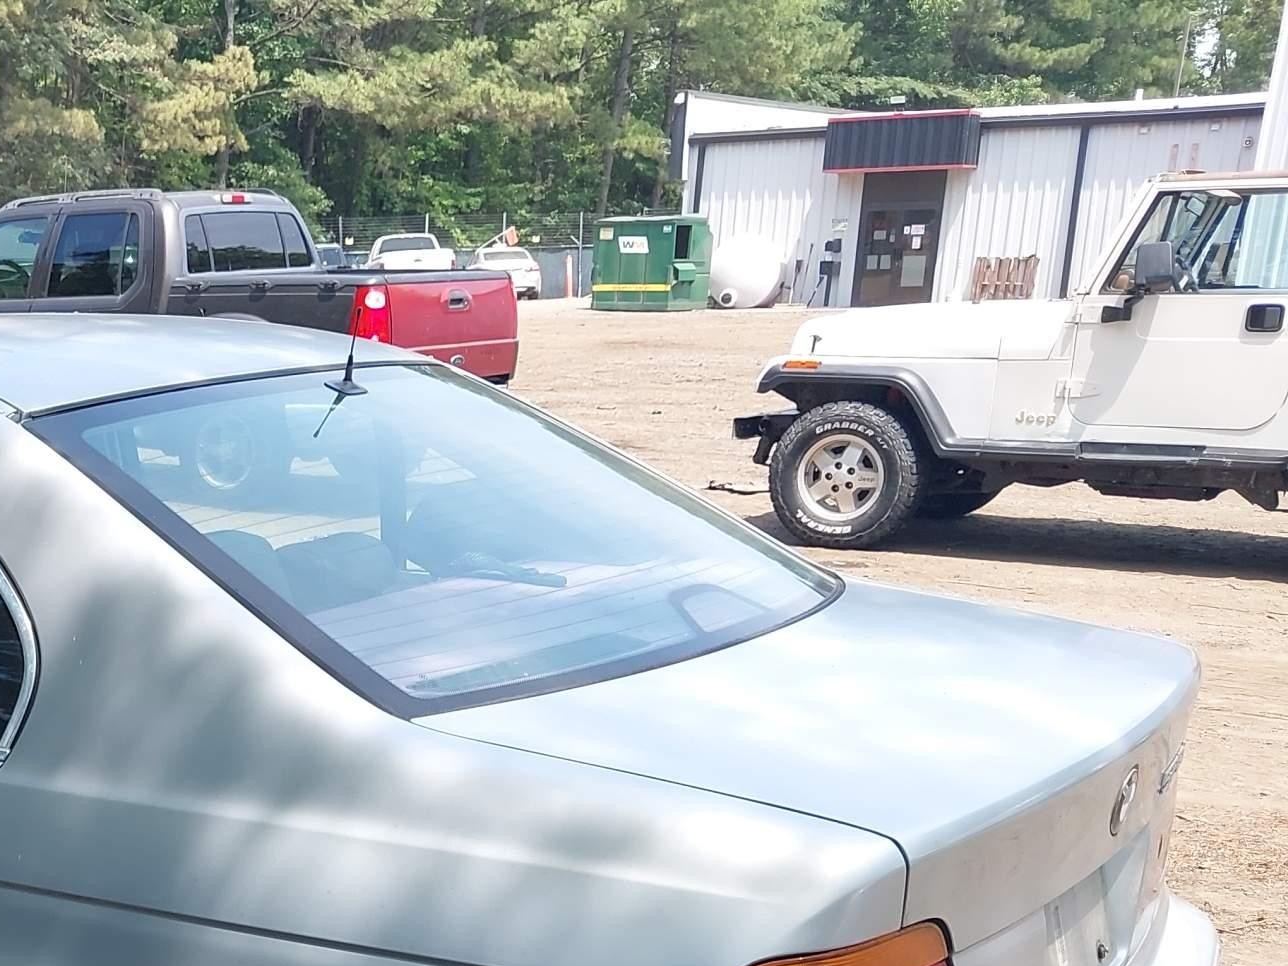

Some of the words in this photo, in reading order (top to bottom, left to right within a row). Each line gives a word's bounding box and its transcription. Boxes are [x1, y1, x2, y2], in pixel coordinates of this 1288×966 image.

[622, 240, 646, 249] WM
[1015, 410, 1057, 428] Jeep
[815, 421, 875, 437] GRABBER
[796, 508, 852, 535] GENERAL
